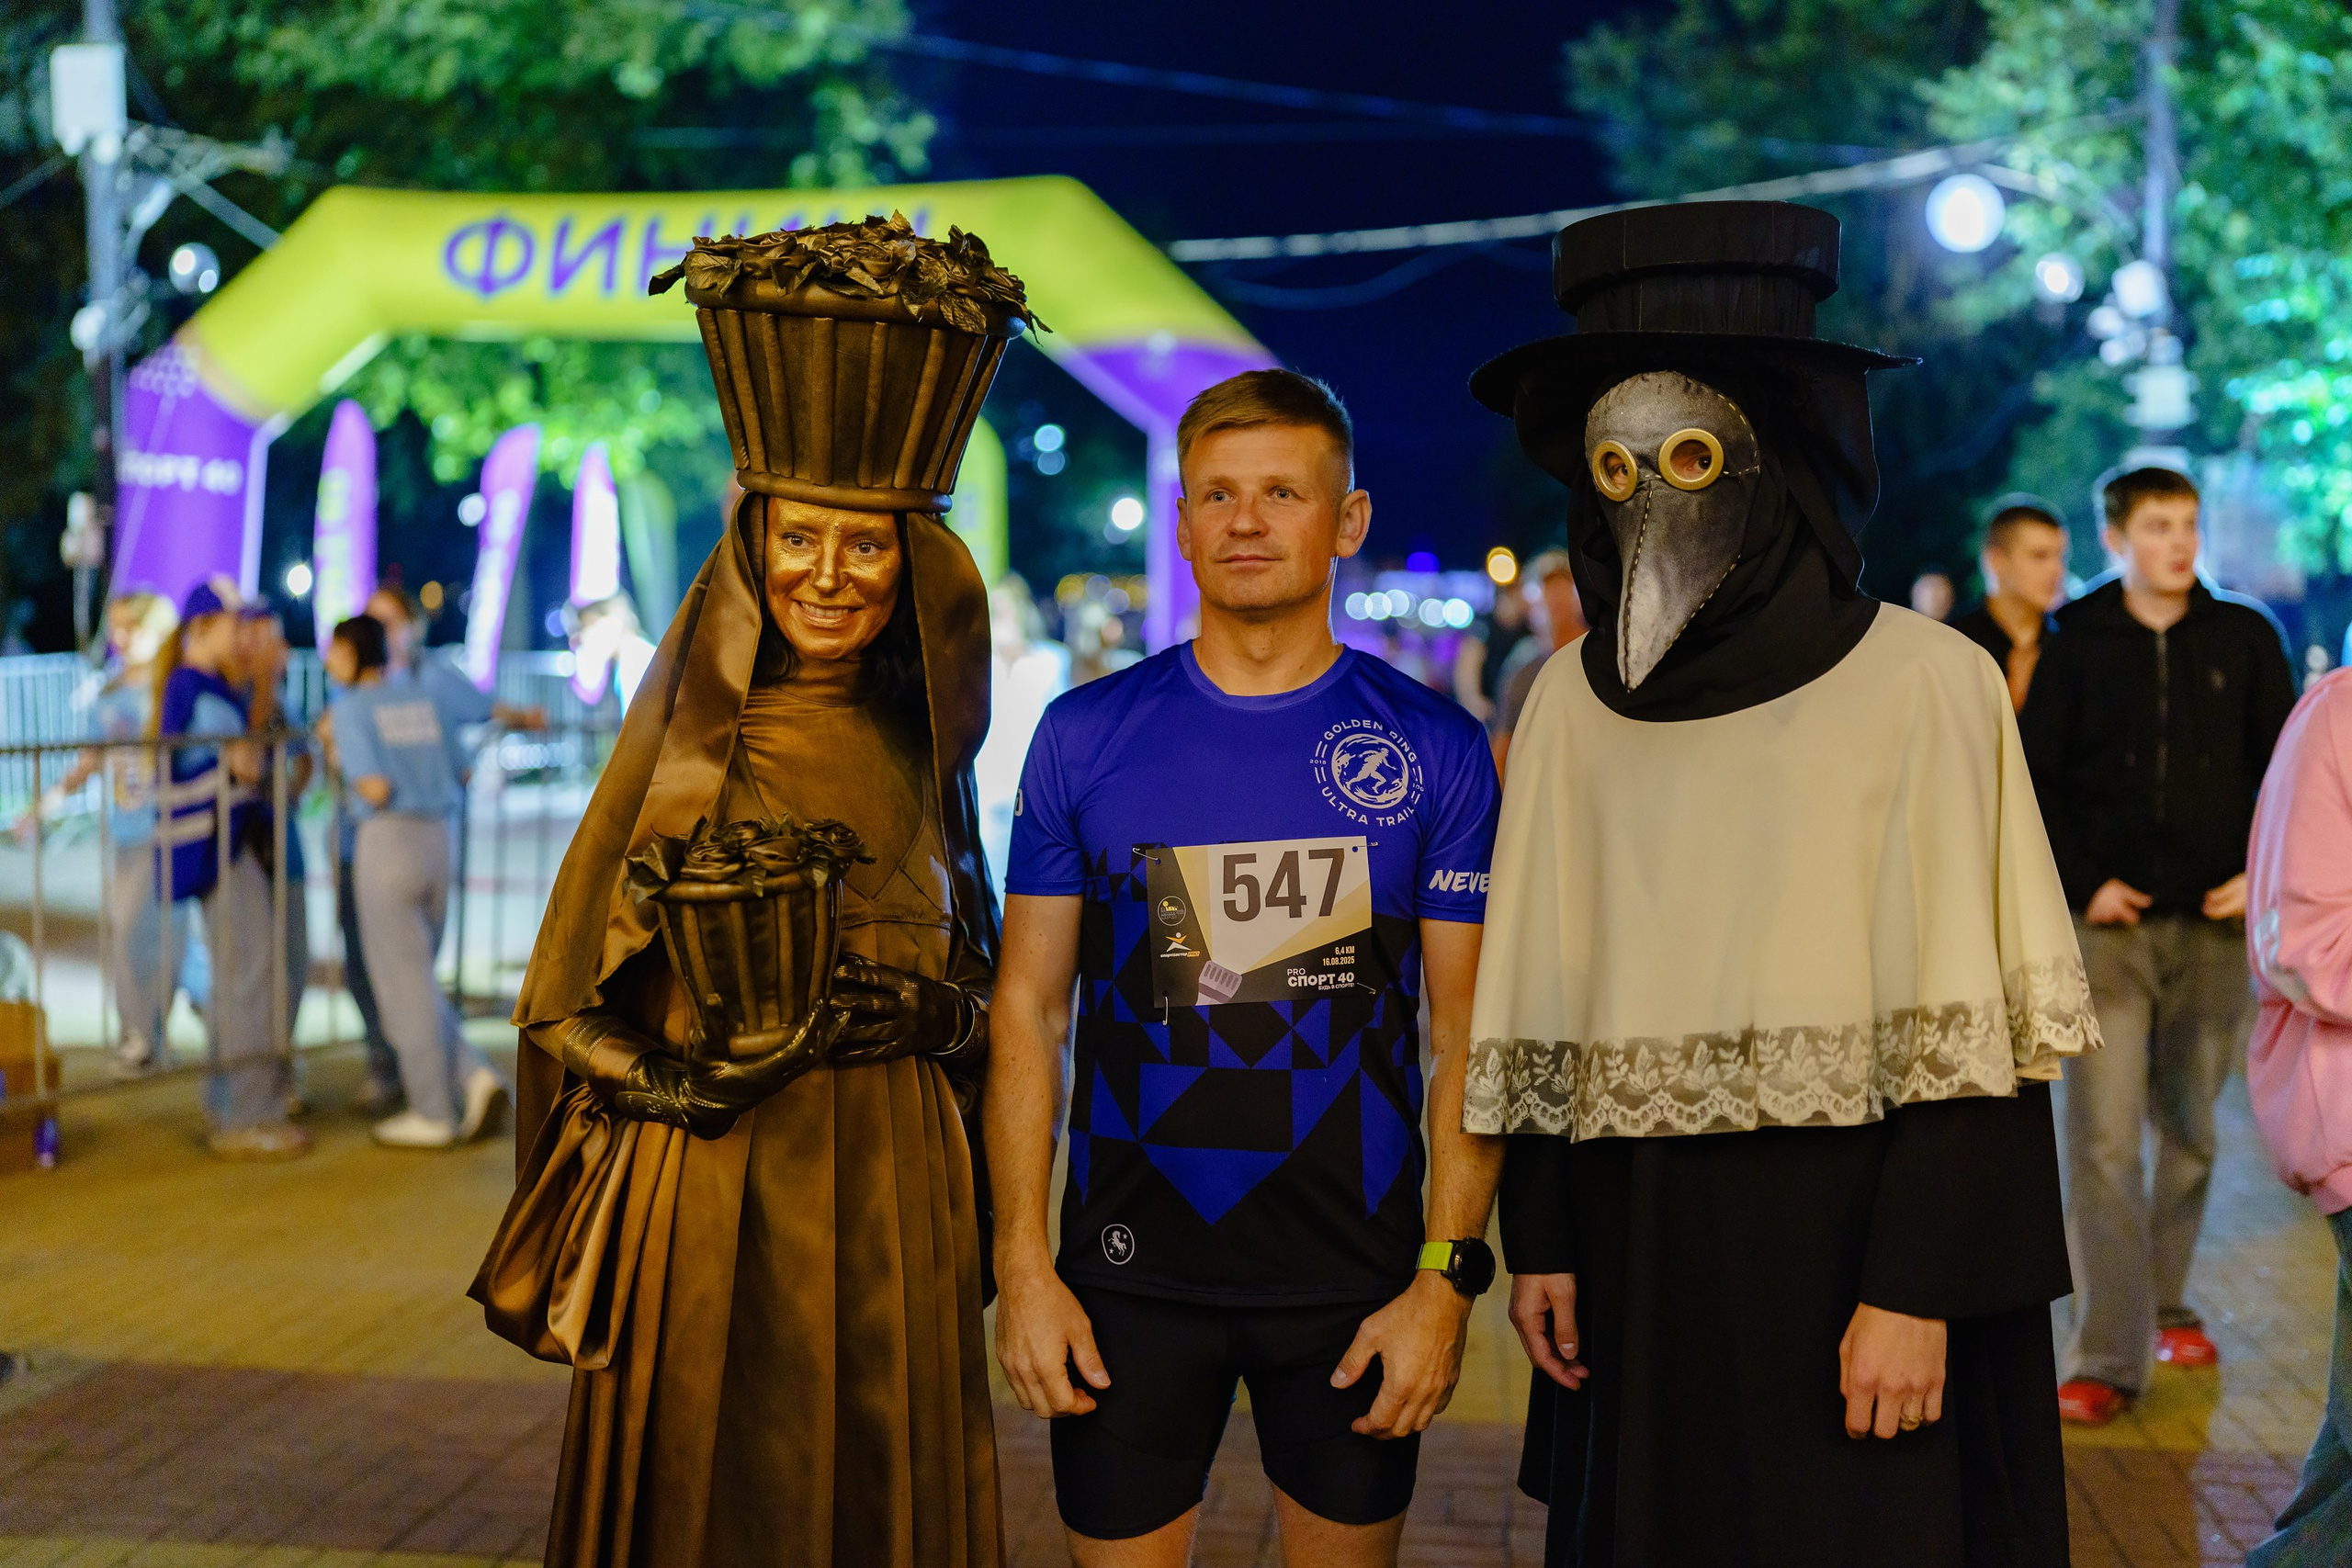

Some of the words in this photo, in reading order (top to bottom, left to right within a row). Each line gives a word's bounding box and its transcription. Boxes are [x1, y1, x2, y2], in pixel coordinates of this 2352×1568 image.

[1324, 719, 1384, 740] GOLDEN
[1388, 731, 1417, 762] RING
[1321, 786, 1369, 825] ULTRA
[1375, 807, 1415, 827] TRAIL
[1223, 848, 1345, 922] 547
[1287, 974, 1336, 987] СПОРТ
[1338, 972, 1355, 983] 40
[1323, 956, 1355, 966] 16.08.2025
